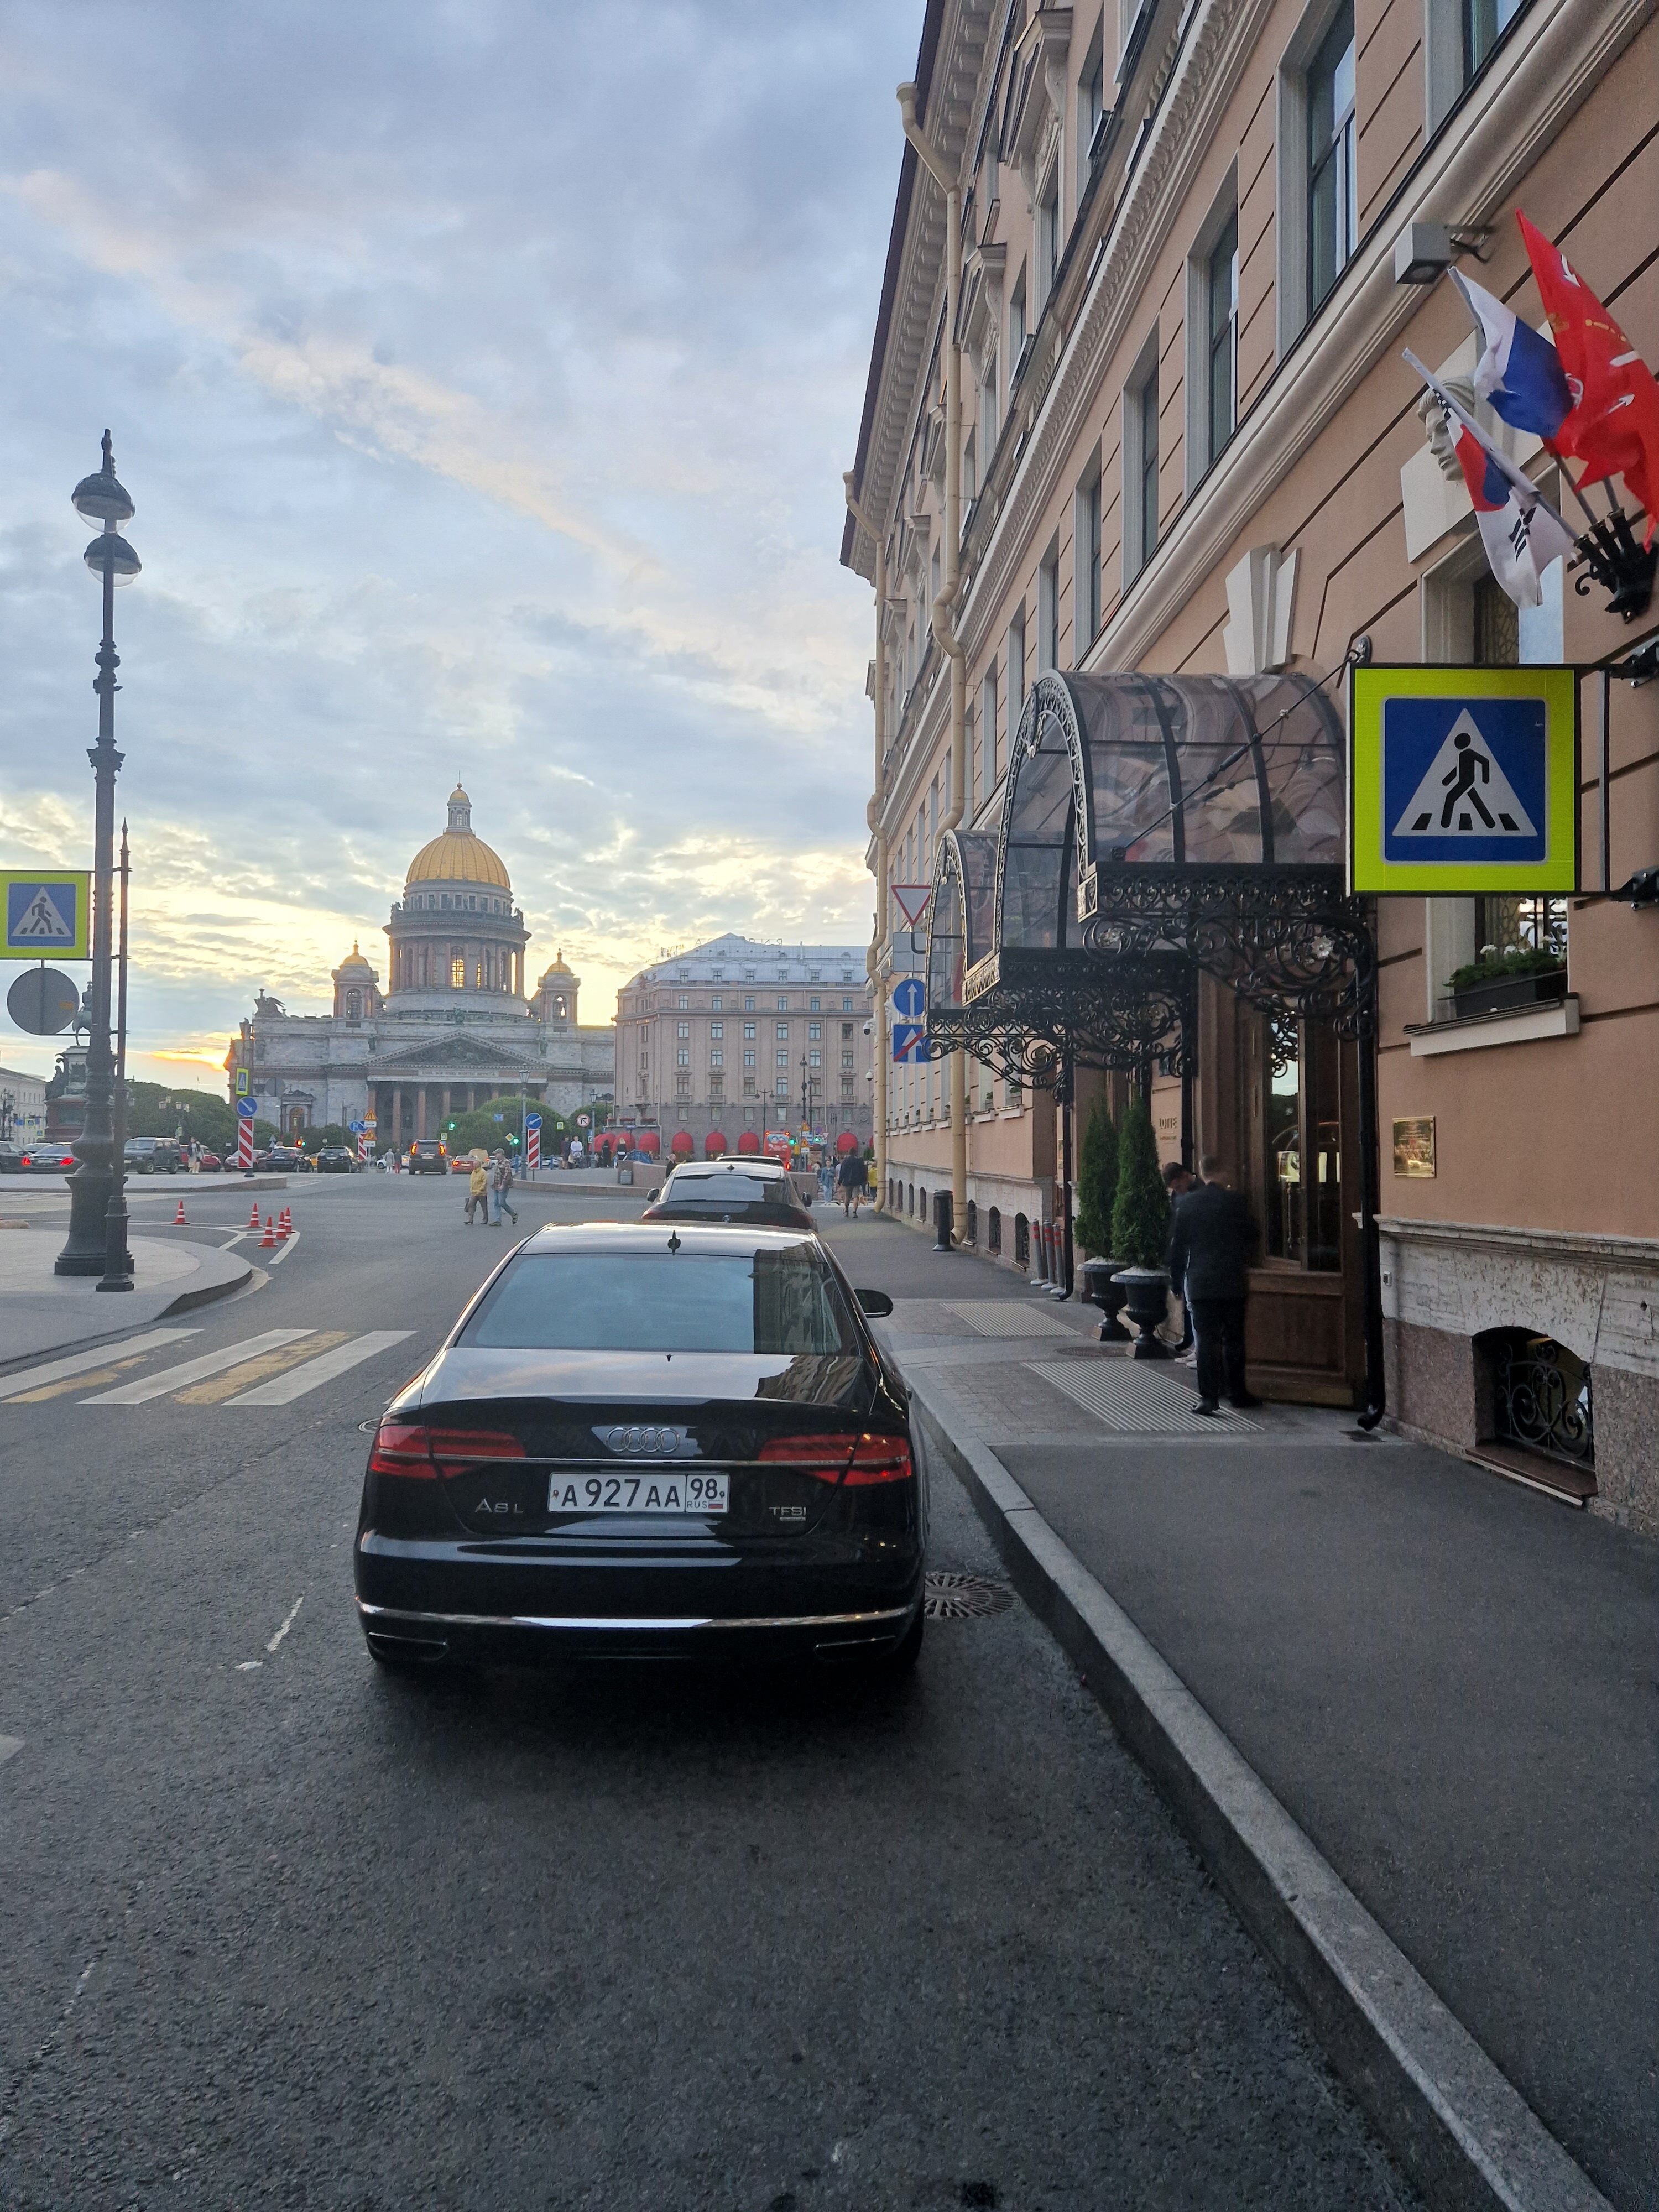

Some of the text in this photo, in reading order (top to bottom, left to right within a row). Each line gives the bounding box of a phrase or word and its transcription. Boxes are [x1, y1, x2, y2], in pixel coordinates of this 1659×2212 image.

[691, 1478, 718, 1500] 98
[687, 1500, 707, 1509] RUS
[769, 1506, 807, 1516] TFSI
